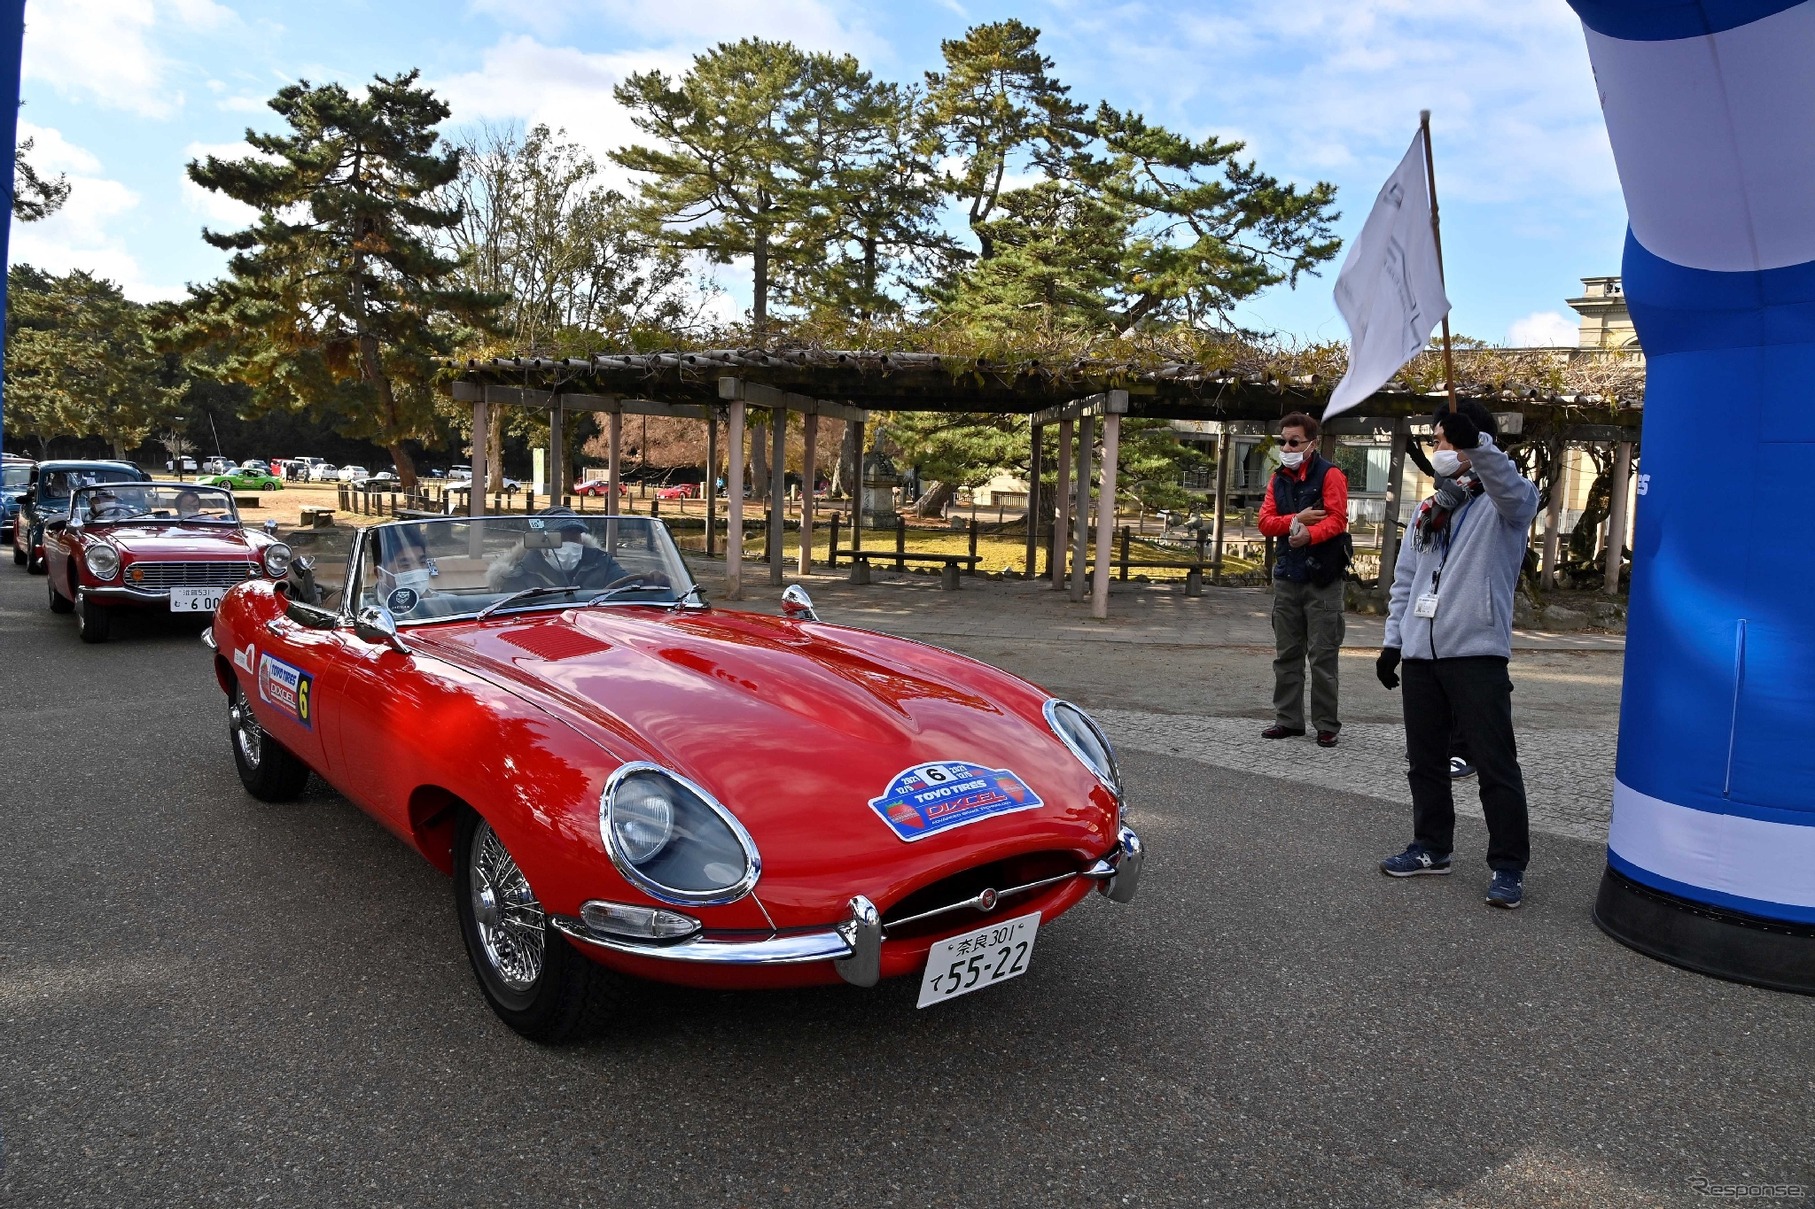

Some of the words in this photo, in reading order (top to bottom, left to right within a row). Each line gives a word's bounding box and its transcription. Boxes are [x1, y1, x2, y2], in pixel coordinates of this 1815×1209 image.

[299, 680, 308, 719] 6
[901, 775, 920, 785] 2021
[925, 768, 947, 782] 6
[895, 785, 914, 795] 12/5
[914, 787, 952, 803] TOYO
[949, 779, 987, 794] TIRES
[928, 792, 1008, 815] DIXCEL
[930, 973, 944, 991] て
[945, 941, 1028, 994] 55-22
